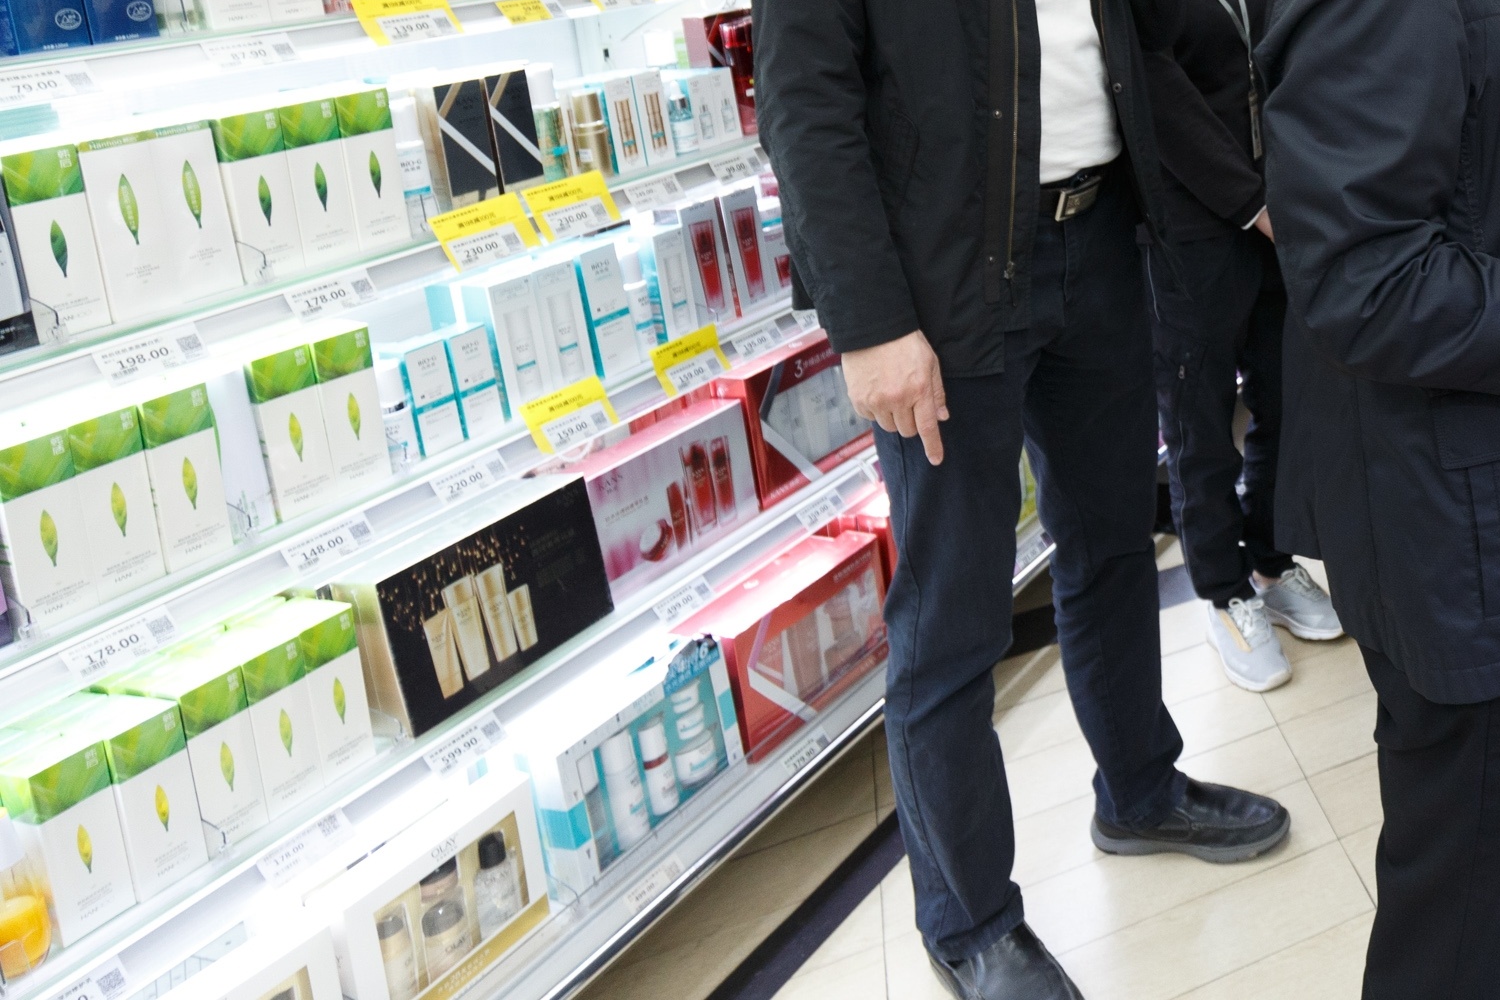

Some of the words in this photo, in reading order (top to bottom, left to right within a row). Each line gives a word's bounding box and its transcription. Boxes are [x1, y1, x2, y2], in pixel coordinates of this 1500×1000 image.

[394, 22, 429, 34] 139.00
[231, 48, 267, 60] 87.90
[12, 81, 58, 95] 79.00
[726, 162, 746, 173] 99.00
[457, 211, 497, 229] 满198减100元
[558, 211, 588, 226] 230.00
[464, 241, 499, 259] 230.00
[304, 289, 346, 308] 178.00
[118, 347, 169, 369] 198.00
[678, 367, 704, 383] 159.00
[557, 421, 588, 440] 159.00
[448, 472, 483, 494] 220.00
[301, 536, 343, 561] 148.00
[666, 594, 693, 616] 499.00
[84, 633, 139, 665] 178.00
[441, 737, 478, 764] 599.90
[430, 836, 458, 860] OLAY
